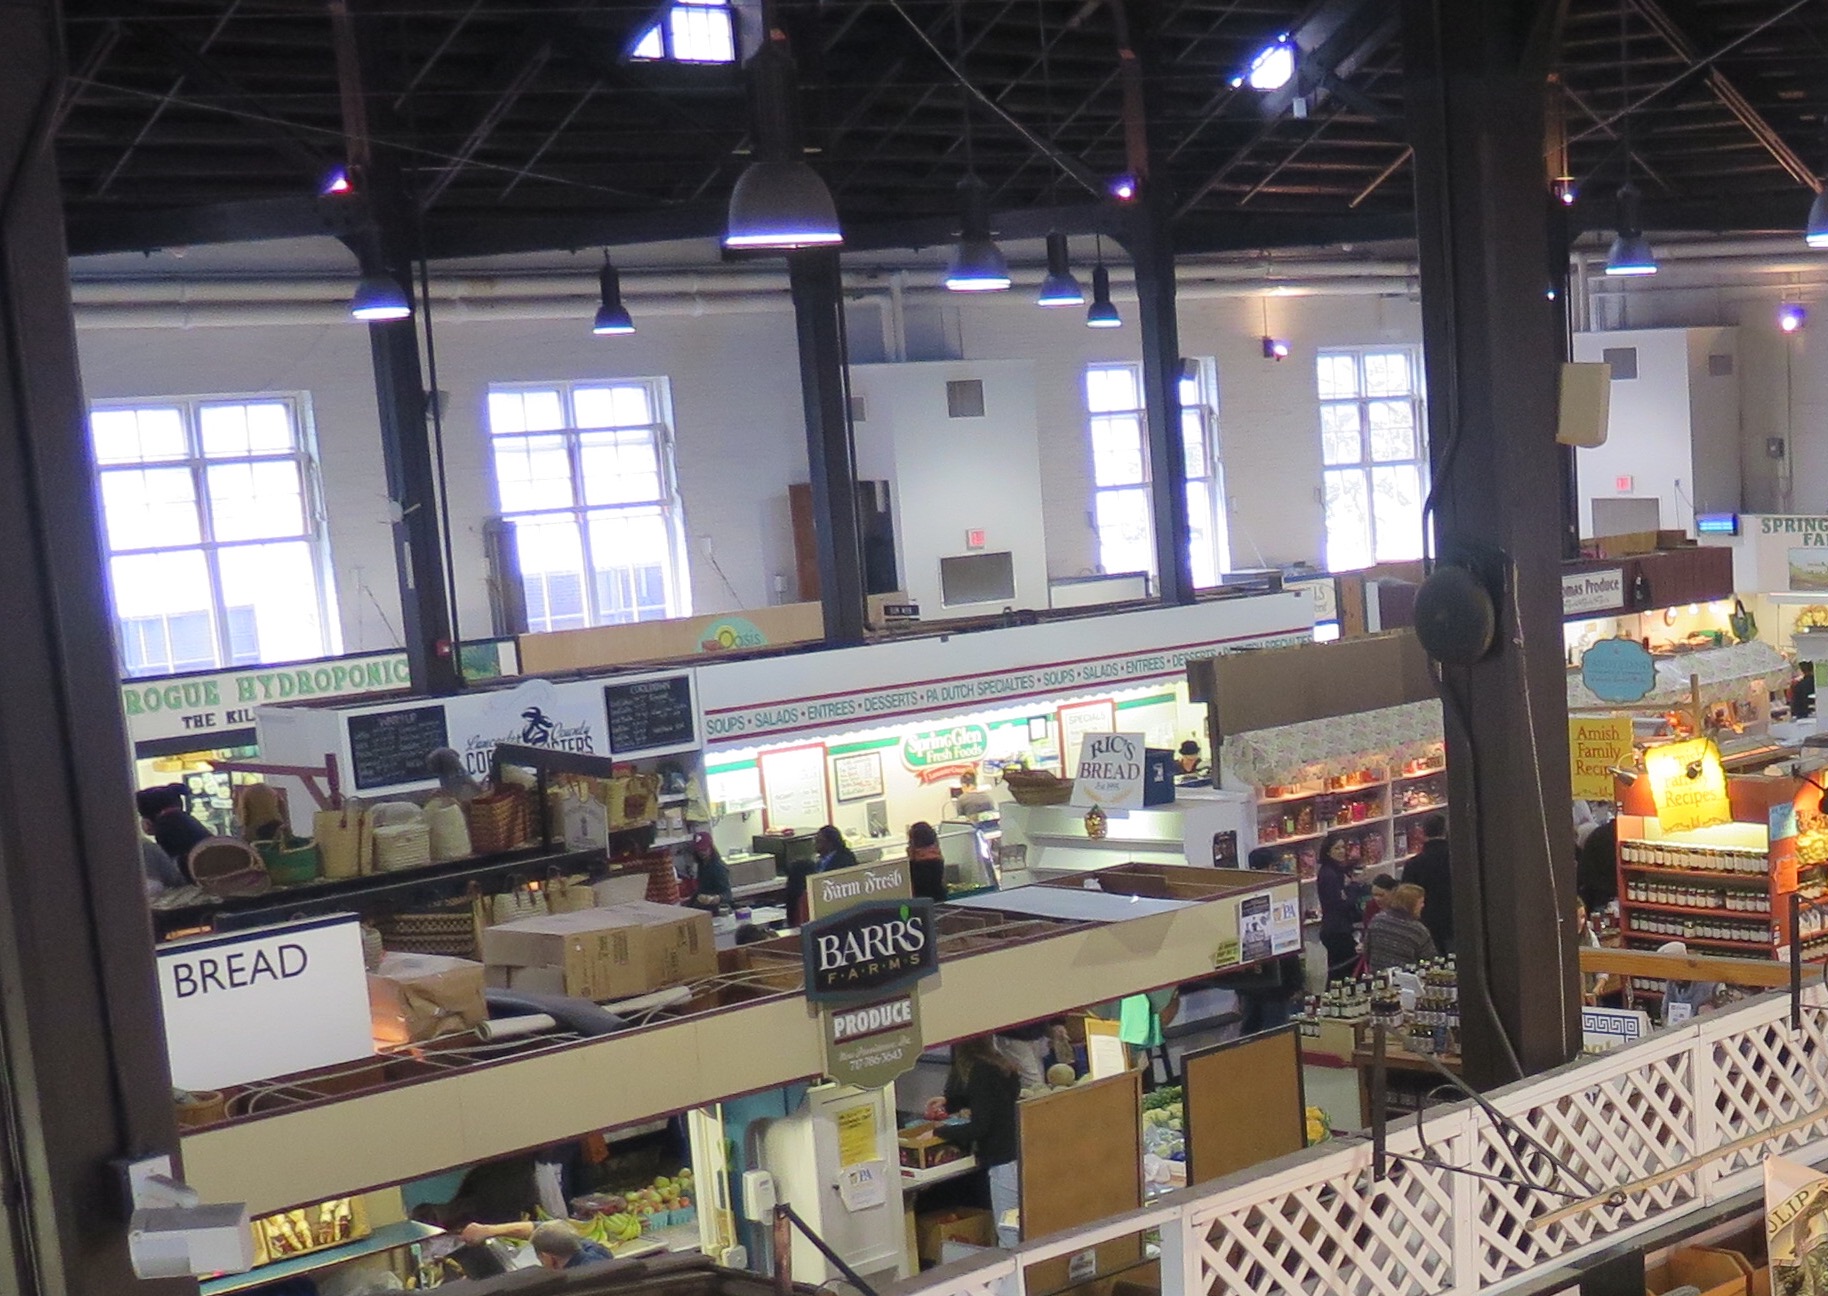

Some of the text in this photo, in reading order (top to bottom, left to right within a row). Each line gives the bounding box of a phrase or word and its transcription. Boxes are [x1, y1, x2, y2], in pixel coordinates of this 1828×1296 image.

[1585, 577, 1620, 595] Produce
[124, 680, 220, 716] ROGUE
[706, 717, 746, 735] SOUPS
[754, 707, 798, 727] SALADS
[807, 698, 856, 720] ENTREES
[864, 690, 918, 712] DESSERTS
[925, 687, 940, 704] PA
[940, 681, 976, 701] DUTCH
[976, 674, 1036, 696] SPECIALTIES
[1043, 669, 1076, 686] SOUPS
[1081, 660, 1119, 680] SALADS
[1125, 654, 1166, 674] ENTREES
[181, 711, 216, 729] THE
[1068, 711, 1106, 725] SPECIALS
[551, 722, 591, 741] County
[907, 724, 984, 757] Spring Glen
[1576, 725, 1620, 741] Amish
[925, 741, 984, 765] Fresh Foods
[1090, 736, 1136, 762] RIC'S
[1577, 742, 1621, 763] Family
[1079, 761, 1142, 782] BREAD
[1664, 786, 1718, 808] Recipes
[822, 868, 903, 902] Farm Fresh
[1283, 903, 1297, 919] PA
[172, 943, 308, 999] BREAD
[833, 1000, 913, 1040] PRODUCE
[860, 1168, 873, 1182] PA
